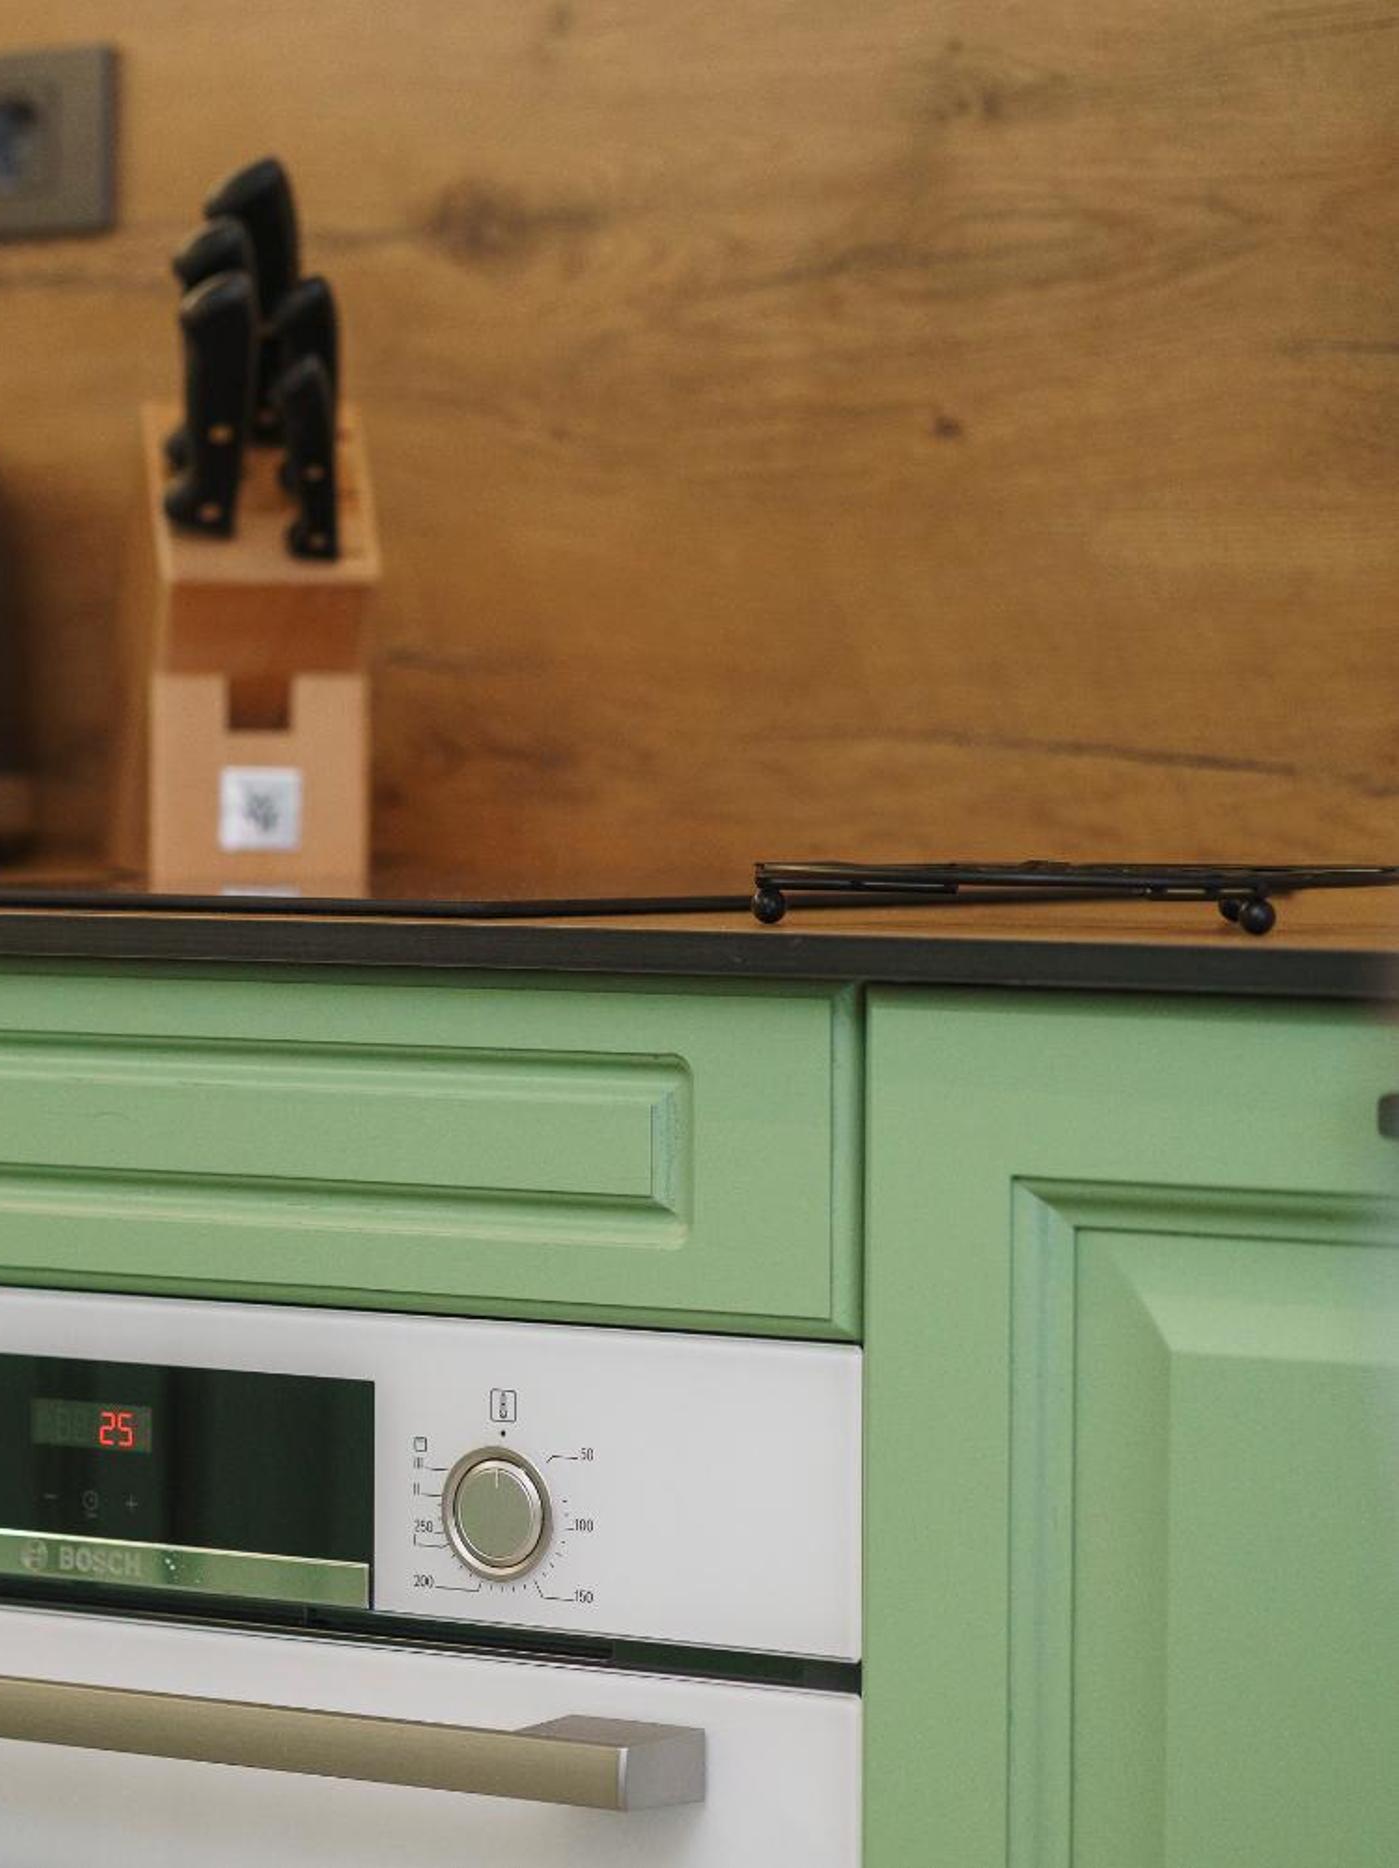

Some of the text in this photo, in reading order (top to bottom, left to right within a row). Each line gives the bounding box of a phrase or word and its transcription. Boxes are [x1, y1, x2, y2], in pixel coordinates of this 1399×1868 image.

[100, 1412, 133, 1446] 25
[580, 1448, 594, 1461] 50
[414, 1520, 433, 1533] 250
[575, 1518, 594, 1532] 100
[59, 1545, 141, 1578] BOSCH
[413, 1574, 434, 1588] 200
[575, 1590, 594, 1604] 150
